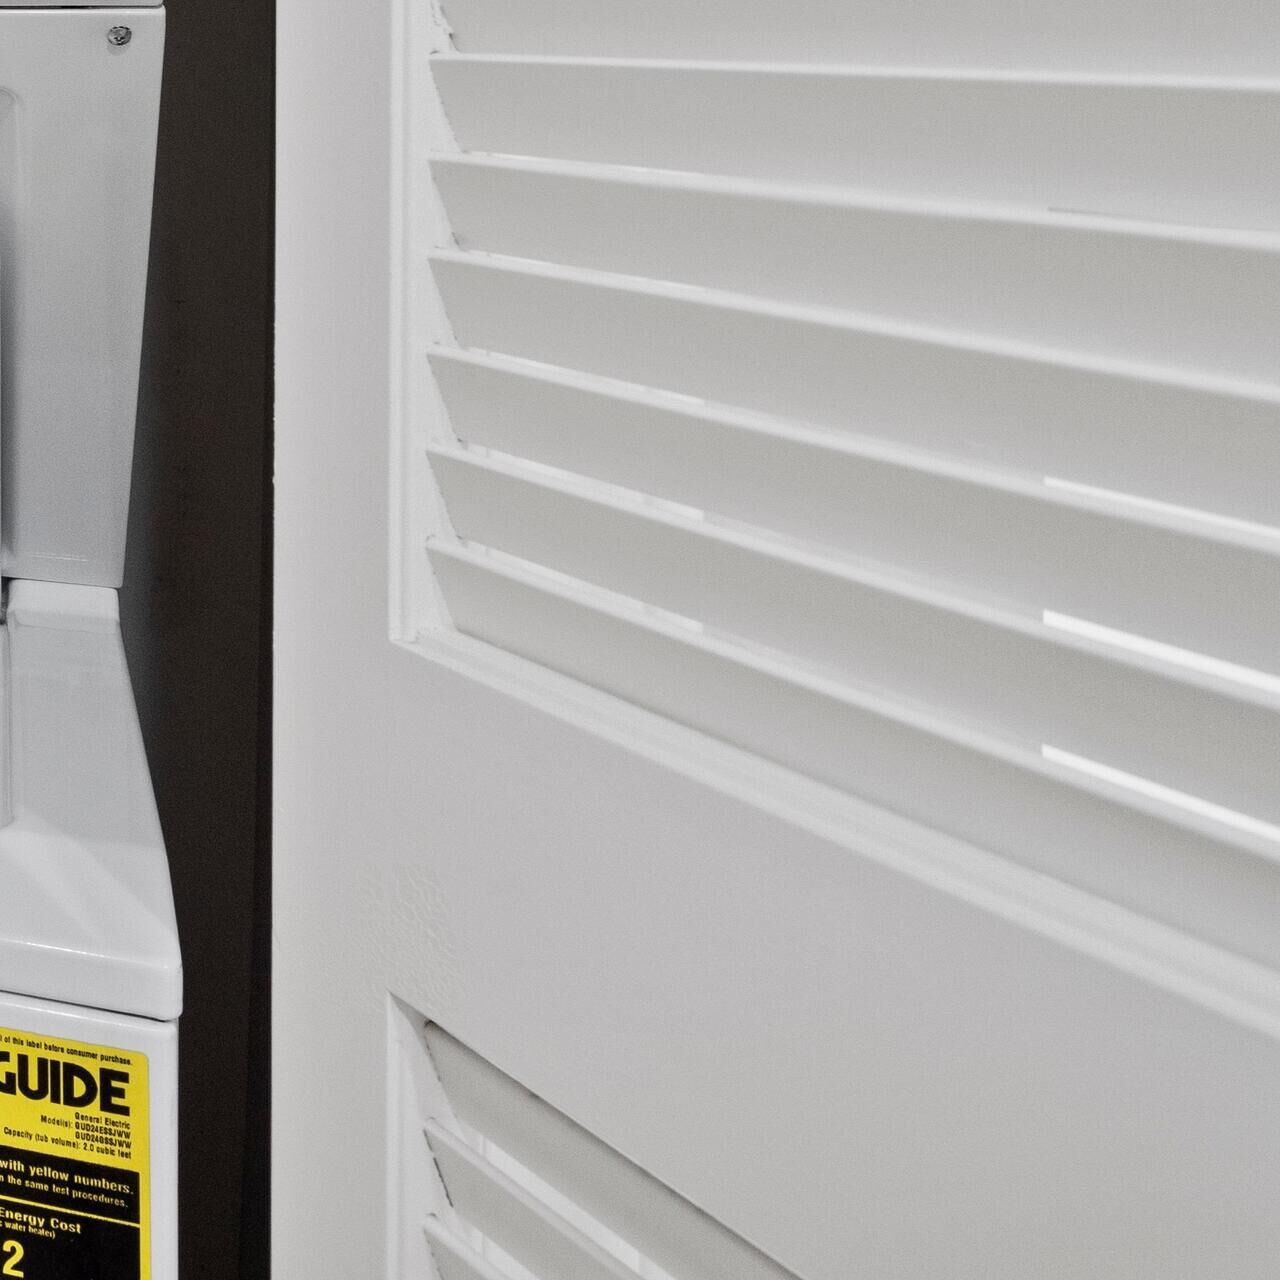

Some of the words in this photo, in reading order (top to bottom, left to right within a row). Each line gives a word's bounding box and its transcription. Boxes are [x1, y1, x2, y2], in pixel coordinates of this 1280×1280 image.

[13, 1036, 24, 1046] this
[26, 1039, 42, 1049] label
[66, 1048, 98, 1060] consumer
[75, 1112, 102, 1124] General
[105, 1118, 130, 1129] Electric
[4, 1127, 32, 1141] Capacity
[83, 1142, 94, 1152] 2.0
[97, 1145, 116, 1156] cubic
[0, 1158, 24, 1172] with
[29, 1165, 69, 1181] yellow
[74, 1175, 134, 1194] numbers.
[8, 1175, 21, 1185] the
[25, 1179, 49, 1191] same
[52, 1184, 69, 1194] test
[72, 1189, 128, 1207] procedures.
[5, 1222, 26, 1233] water
[50, 1218, 81, 1234] Cost
